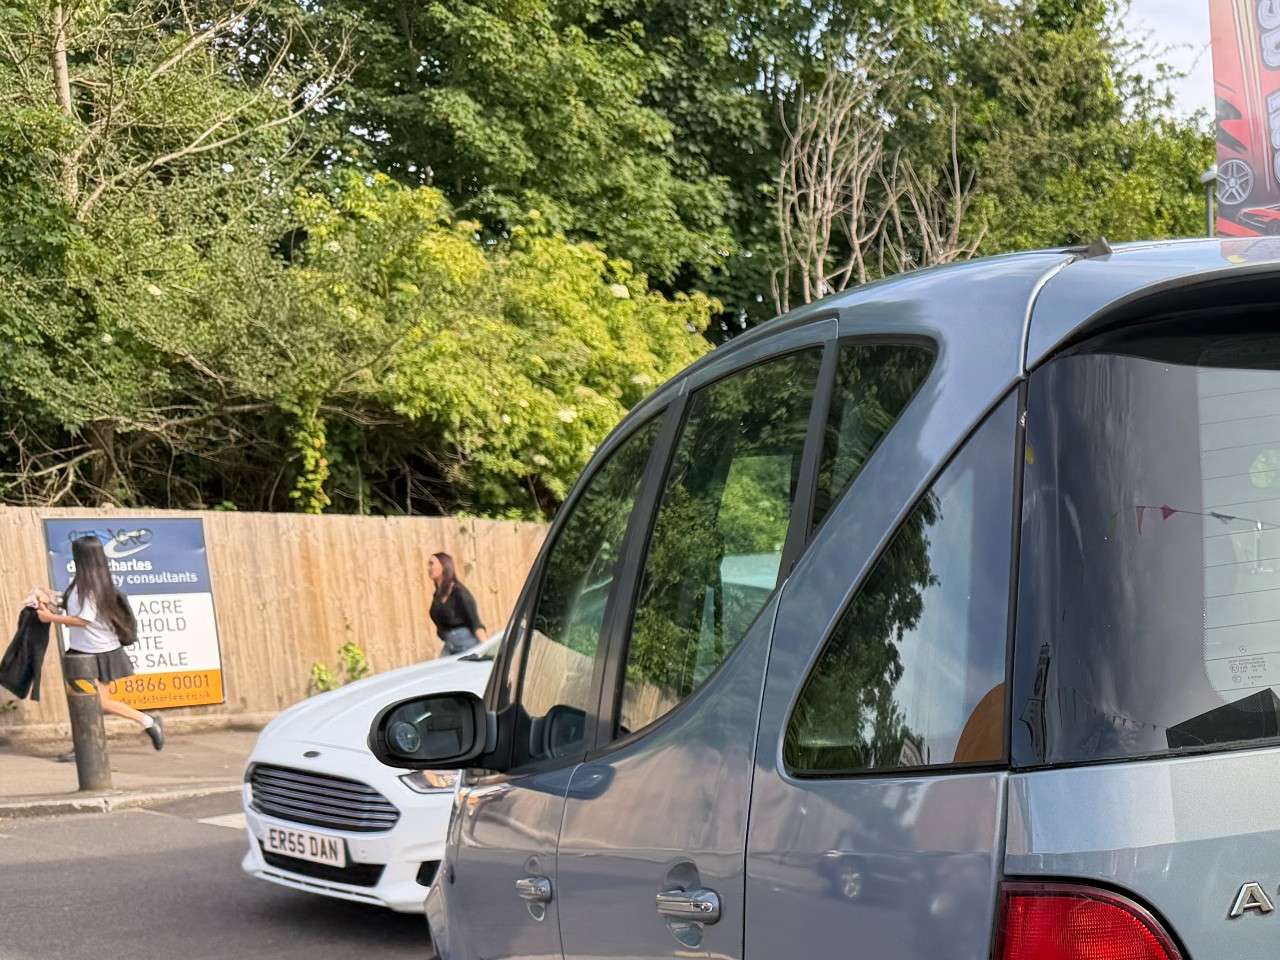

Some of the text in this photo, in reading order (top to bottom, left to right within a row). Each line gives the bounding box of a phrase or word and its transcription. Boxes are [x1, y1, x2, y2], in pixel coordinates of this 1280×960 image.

[127, 572, 198, 585] consultants
[138, 600, 184, 616] ACRE
[137, 617, 187, 632] HOLD
[146, 652, 189, 668] SALE
[124, 677, 167, 694] 8866
[172, 674, 210, 691] 0001
[269, 828, 338, 861] ER55 DAN
